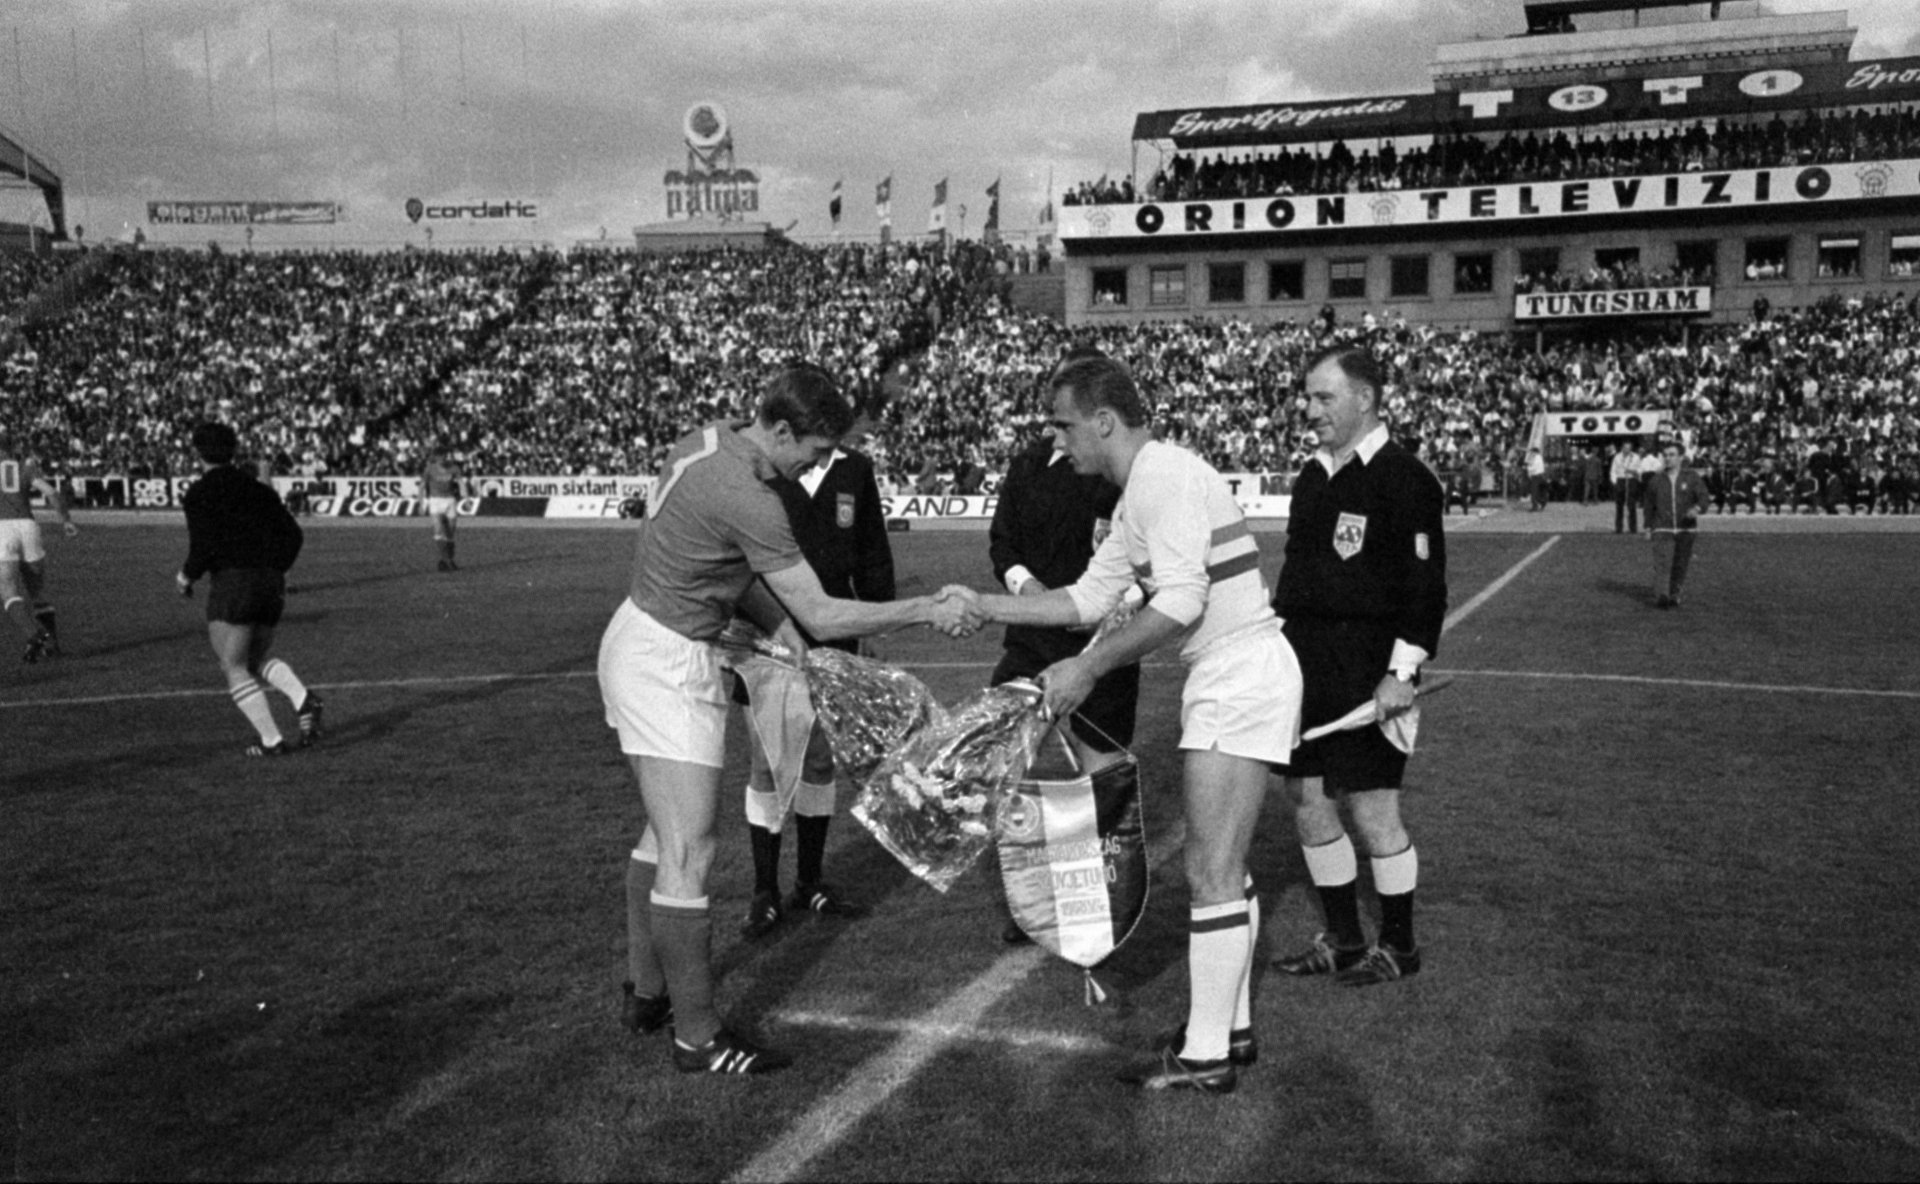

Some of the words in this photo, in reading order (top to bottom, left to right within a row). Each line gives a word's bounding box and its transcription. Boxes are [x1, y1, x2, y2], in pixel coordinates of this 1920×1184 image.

[426, 200, 536, 218] cordatic
[1135, 196, 1345, 234] ORION
[1526, 290, 1699, 316] TUNGSRAM
[1561, 415, 1642, 433] TOTO
[510, 480, 558, 496] Braun
[563, 479, 617, 496] sixtant
[901, 497, 968, 517] AND
